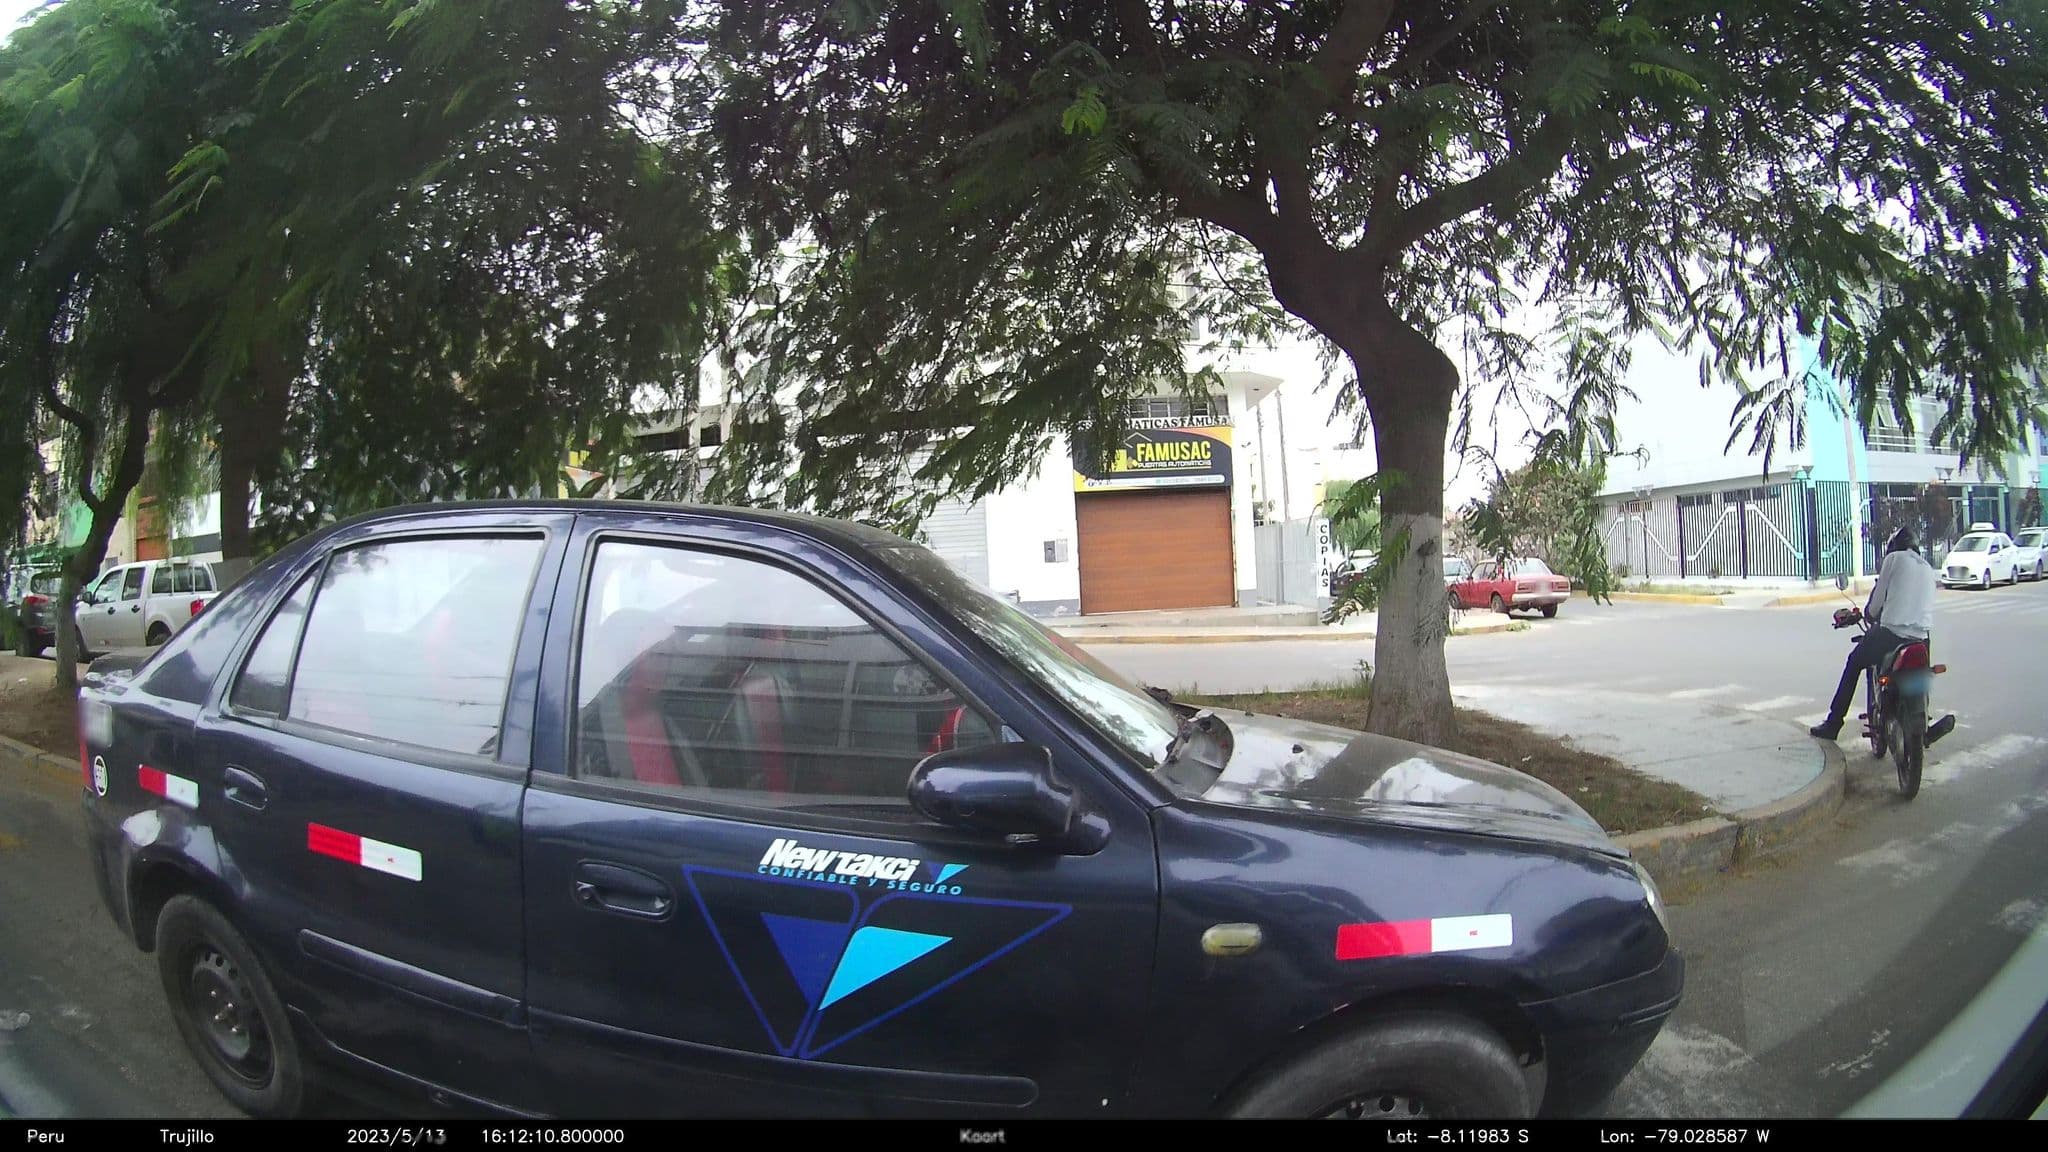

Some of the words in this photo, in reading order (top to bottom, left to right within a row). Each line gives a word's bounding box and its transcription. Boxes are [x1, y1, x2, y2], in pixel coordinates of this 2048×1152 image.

[1136, 440, 1212, 461] FAMUSAC
[1320, 525, 1329, 588] COPIAS
[758, 865, 858, 885] CONFIABLE
[887, 880, 963, 895] SEGURO
